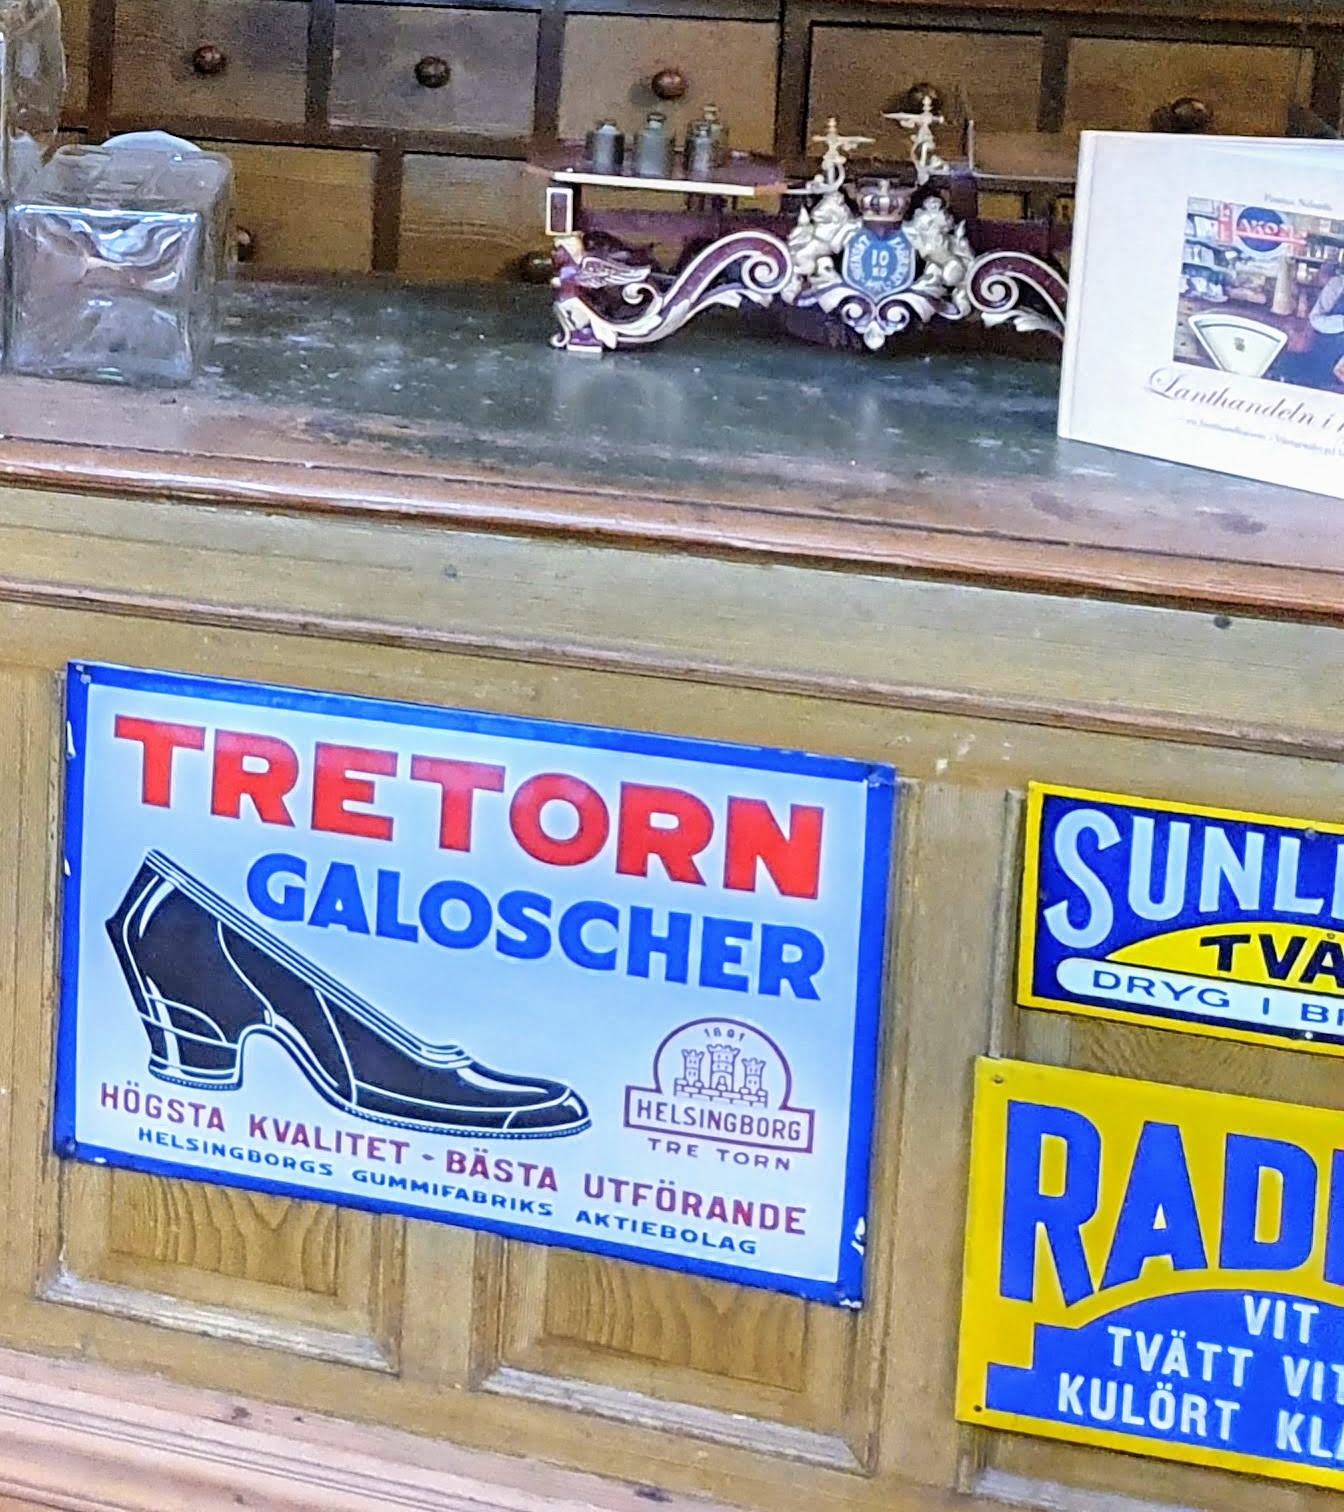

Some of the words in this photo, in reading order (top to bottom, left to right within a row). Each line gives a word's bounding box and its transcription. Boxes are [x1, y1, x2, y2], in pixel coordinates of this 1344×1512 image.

[871, 248, 890, 266] 10
[1146, 366, 1315, 429] Lanthandeln
[113, 713, 826, 901] TRETORN
[244, 851, 827, 1002] GALOSCHER
[1092, 969, 1230, 1011] DRYG
[1261, 996, 1270, 1017] I
[700, 1025, 748, 1043] 1891
[635, 1097, 804, 1145] HELSINGBORG
[99, 1078, 226, 1133] HÖGSTA
[248, 1114, 407, 1167] KVALITET
[444, 1143, 560, 1194] BÄSTA
[582, 1170, 808, 1237] UTFÖRANDE
[646, 1136, 701, 1161] TRE
[715, 1146, 794, 1172] TORN
[137, 1126, 334, 1178] HELSINGBORGS
[351, 1169, 554, 1219] GUMMIFABRIKS
[573, 1208, 759, 1257] AKTIEBOLAG
[999, 1098, 1344, 1310] RADI
[1243, 1293, 1320, 1345] VIT
[1107, 1324, 1255, 1390] TVÄTT
[1057, 1371, 1241, 1442] KULÖRT
